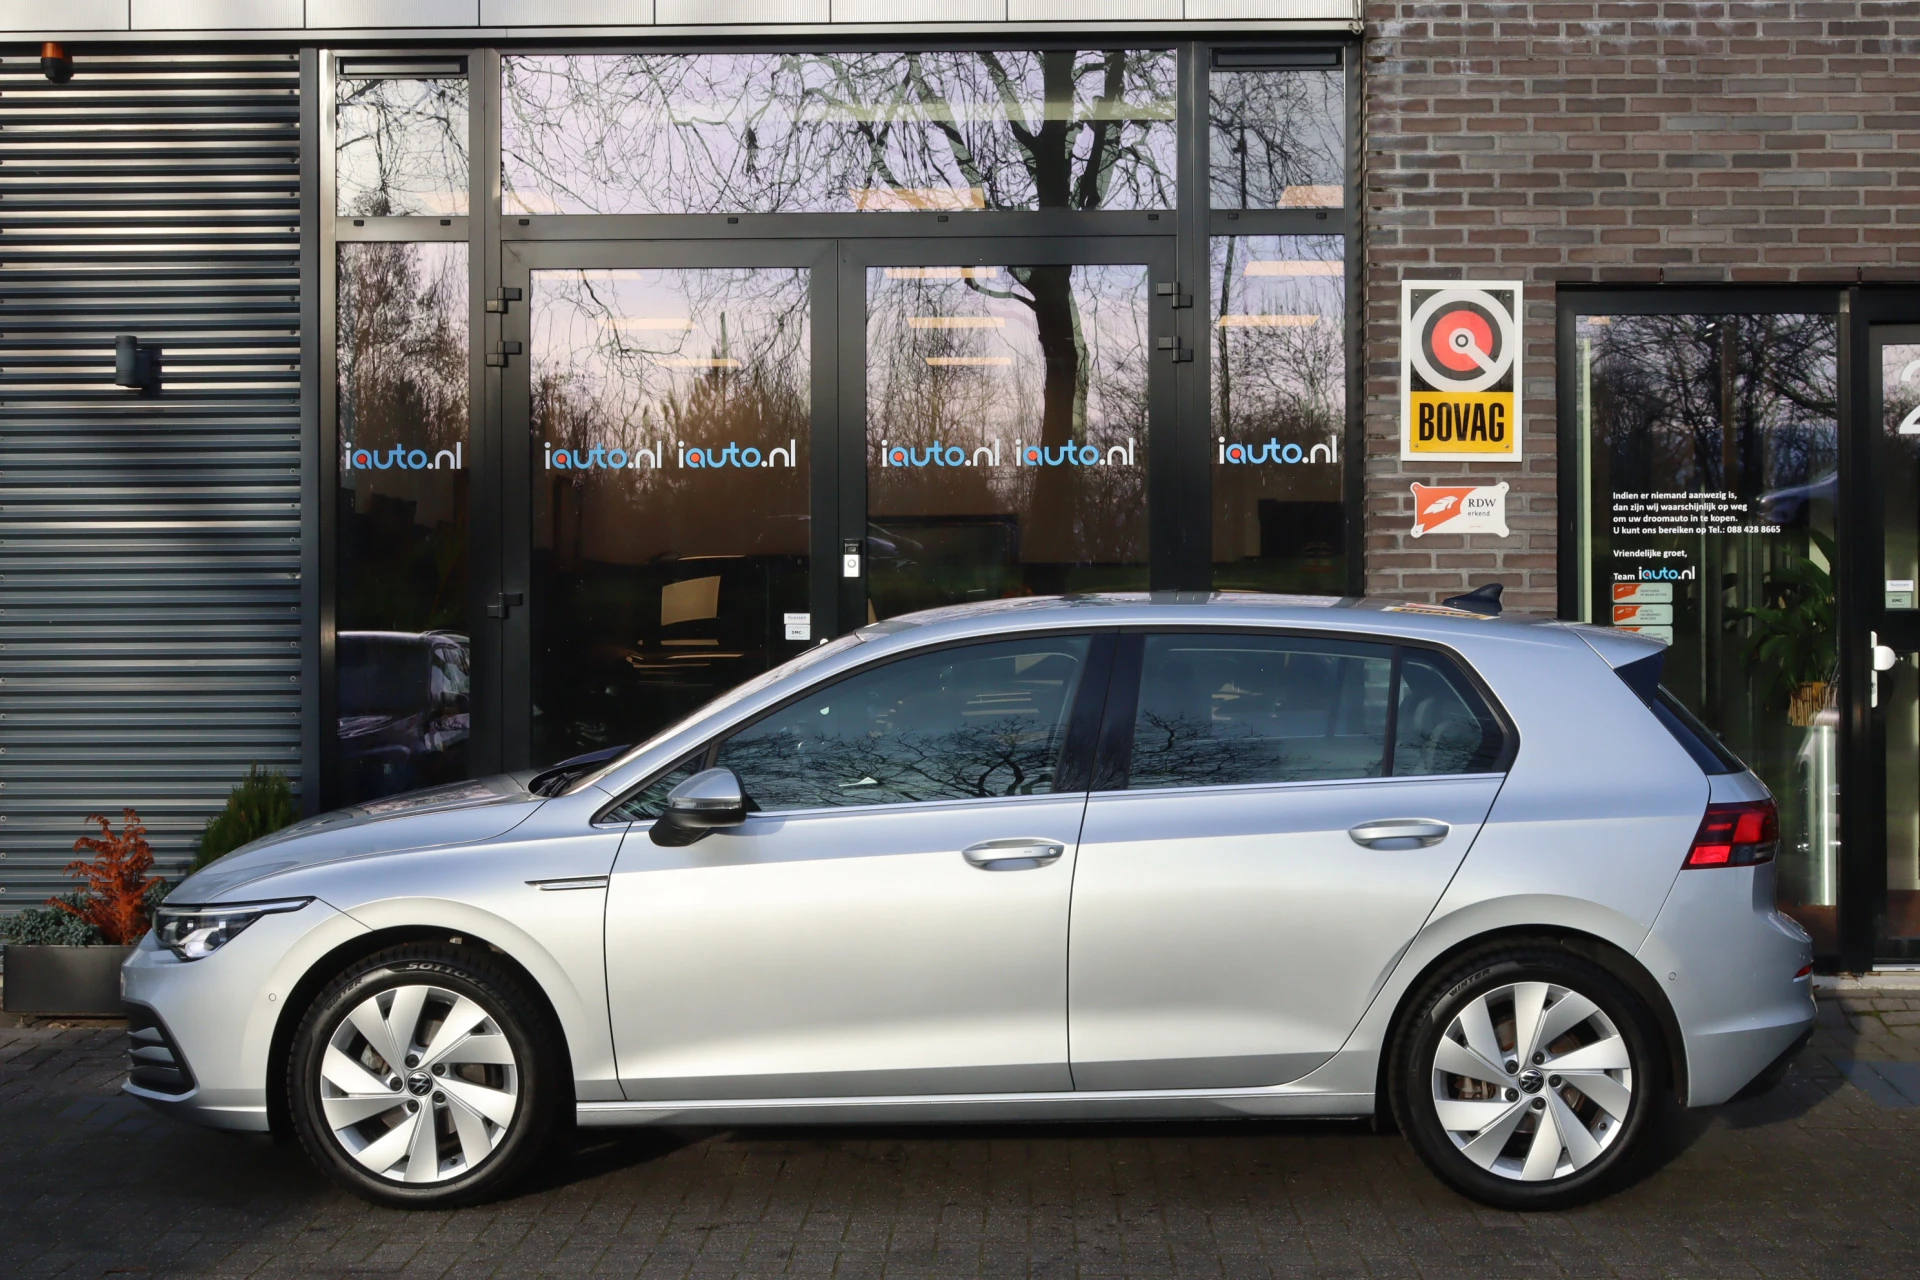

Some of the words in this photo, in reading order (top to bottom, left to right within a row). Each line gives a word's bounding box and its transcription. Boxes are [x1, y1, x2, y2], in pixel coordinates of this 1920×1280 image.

[1419, 402, 1504, 442] BOVAG
[345, 441, 462, 470] iauto.nl
[544, 440, 662, 469] iauto.nl
[677, 438, 796, 468] iauto.nl
[881, 438, 1000, 467] iauto.nl
[1015, 437, 1134, 466] iauto.nl
[1218, 434, 1337, 465] iauto.nl
[1468, 498, 1497, 508] RDW
[1613, 491, 1639, 500] Indien
[1651, 491, 1687, 499] niemand
[1689, 492, 1727, 501] aanwezig
[1729, 491, 1737, 500] is,
[1613, 503, 1629, 511] dan
[1631, 504, 1645, 513] zijn
[1647, 504, 1659, 513] wij
[1661, 503, 1716, 512] waarschijnlijk
[1718, 504, 1729, 512] op
[1731, 504, 1748, 512] weg
[1643, 514, 1689, 523] droomauto
[1691, 514, 1699, 522] in
[1700, 514, 1709, 522] te
[1711, 515, 1738, 524] kopen.
[1614, 526, 1620, 534] U
[1622, 526, 1641, 534] kunt
[1659, 525, 1694, 534] bereiken
[1696, 527, 1707, 536] op
[1709, 525, 1725, 534] Tel.:
[1727, 525, 1743, 534] 088
[1744, 525, 1759, 534] 428
[1761, 525, 1781, 534] 8665
[1614, 550, 1662, 559] Vriendelijke
[1664, 550, 1688, 559] groet,
[1614, 572, 1636, 581] Team
[1639, 566, 1696, 580] iauto.nl
[1448, 967, 1492, 997] WINTER
